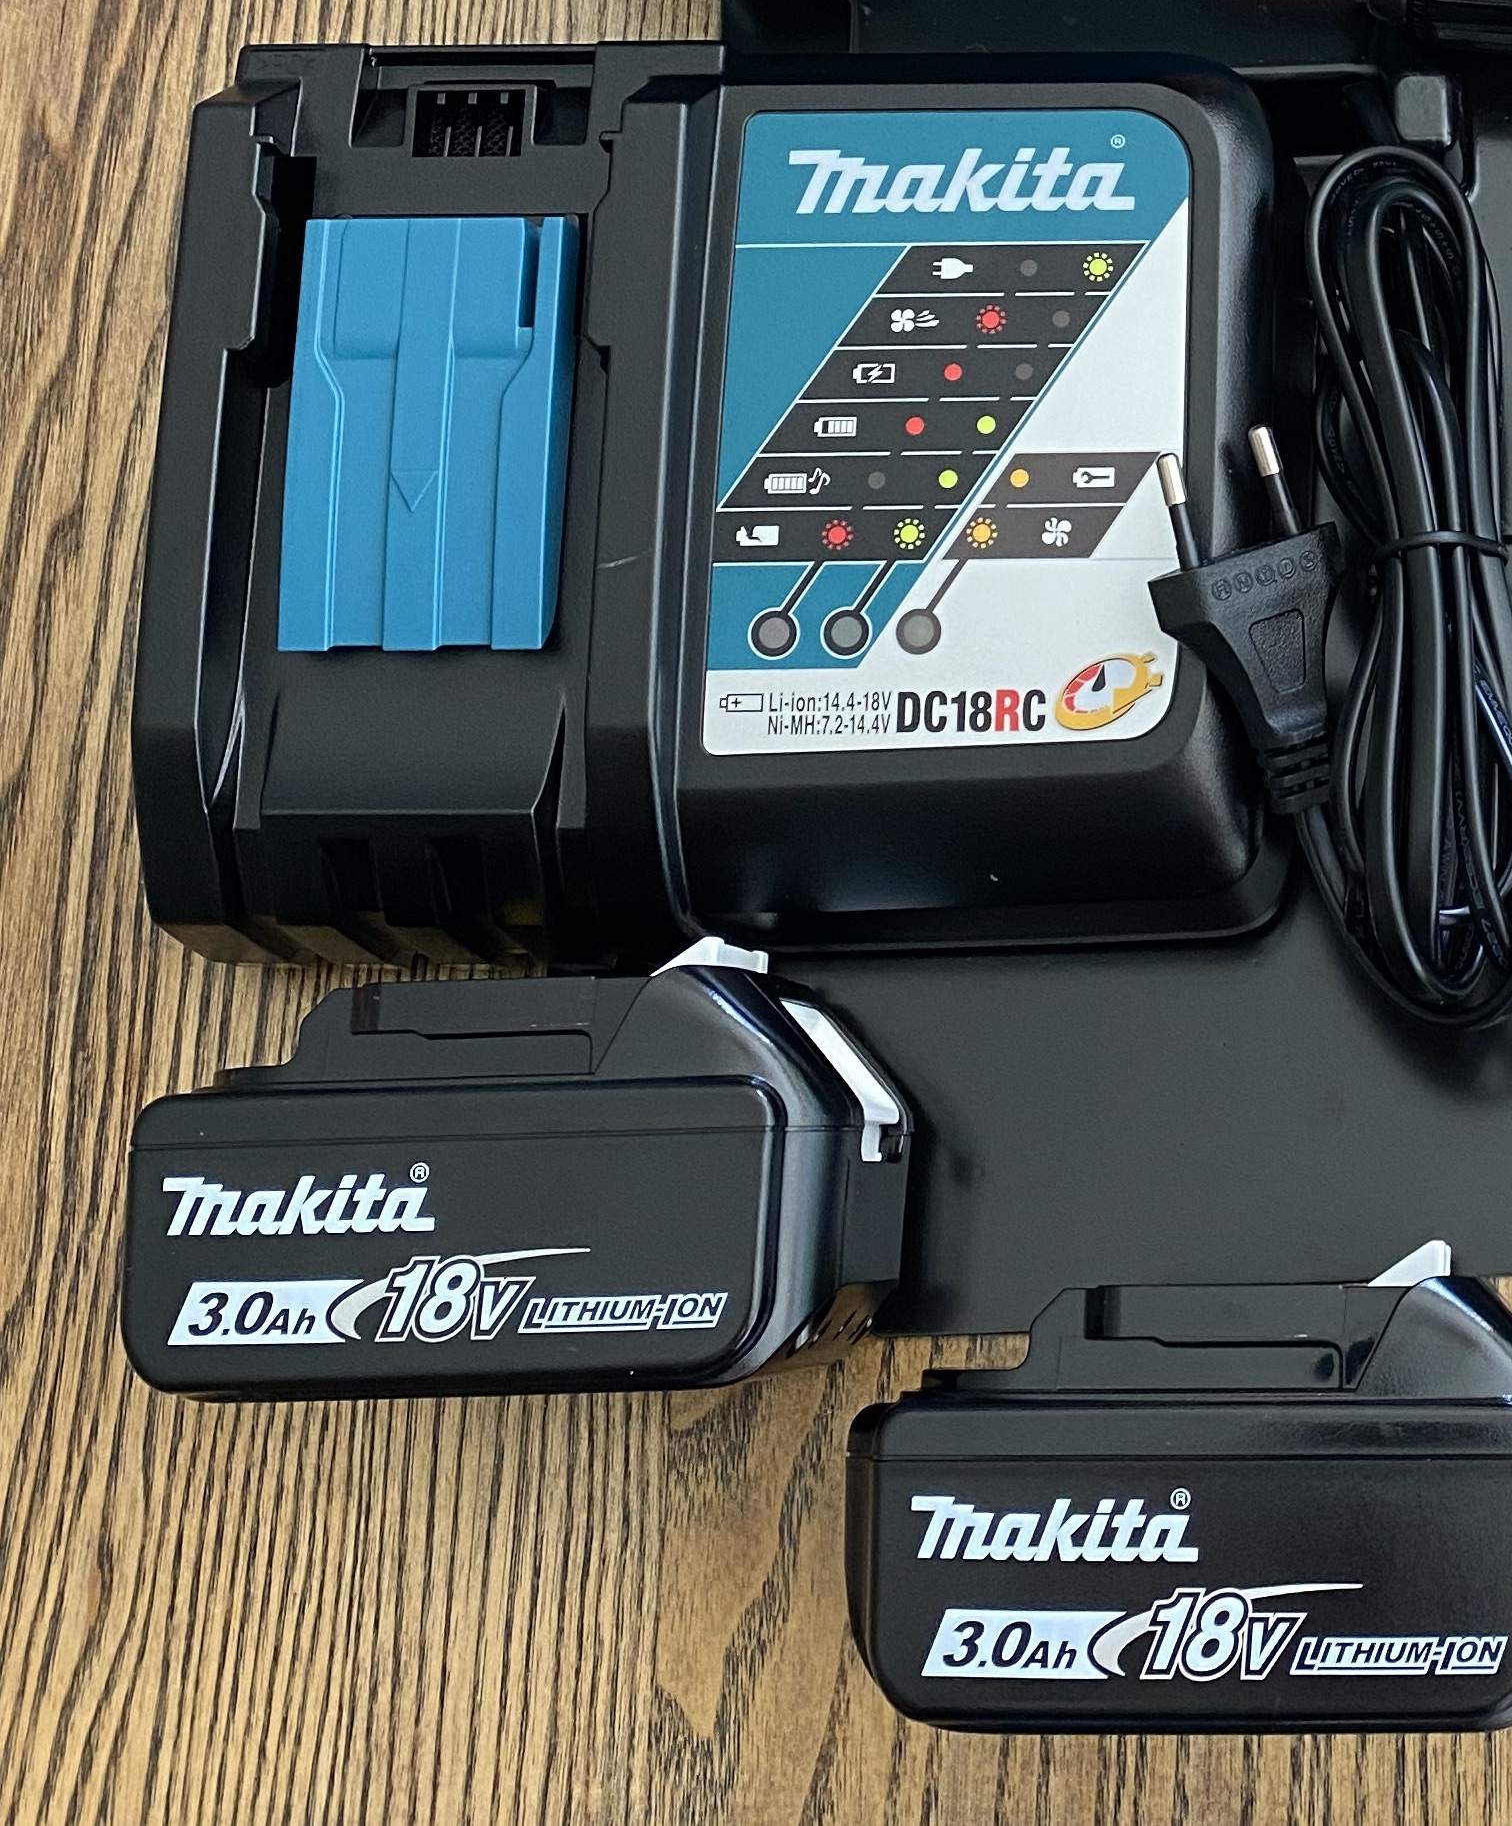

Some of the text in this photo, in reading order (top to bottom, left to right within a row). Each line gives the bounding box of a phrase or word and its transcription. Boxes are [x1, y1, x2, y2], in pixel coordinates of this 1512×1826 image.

[788, 147, 1136, 214] makita
[767, 713, 892, 736] Ni-MH:7.2-14.4V
[896, 689, 1046, 734] DC18RC
[162, 1174, 435, 1237] makita
[188, 1255, 729, 1343] 3.0Ah 18V LITHIUM-ION
[911, 1496, 1199, 1562] makita
[943, 1587, 1509, 1682] 3.0Ah 18V LITHIUM-ION
